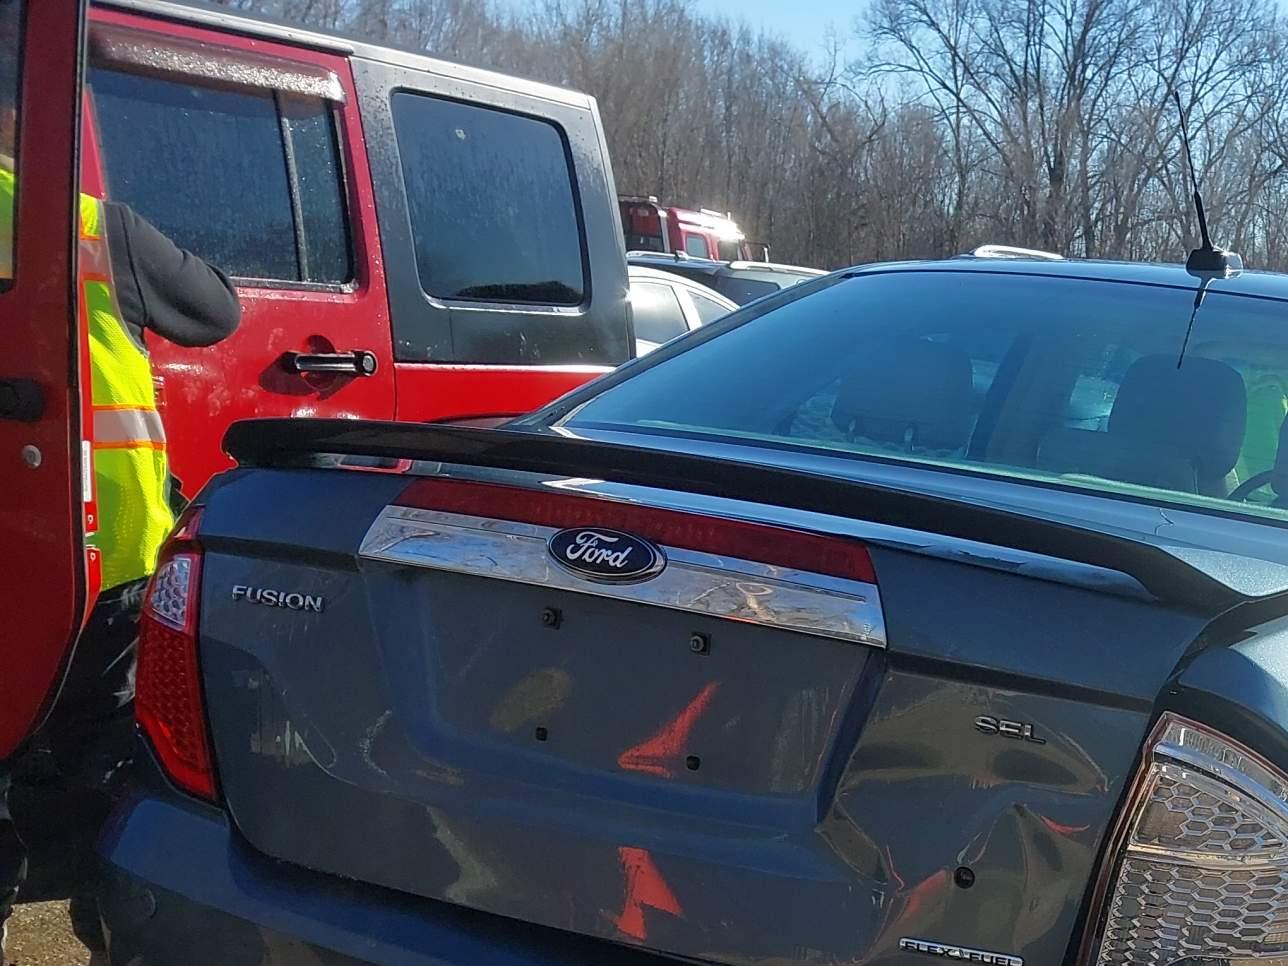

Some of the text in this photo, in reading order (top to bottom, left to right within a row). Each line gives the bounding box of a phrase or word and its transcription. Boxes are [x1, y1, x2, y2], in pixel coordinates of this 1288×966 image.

[566, 531, 633, 568] Ford
[231, 584, 323, 612] FUSION
[975, 715, 1045, 743] SEL
